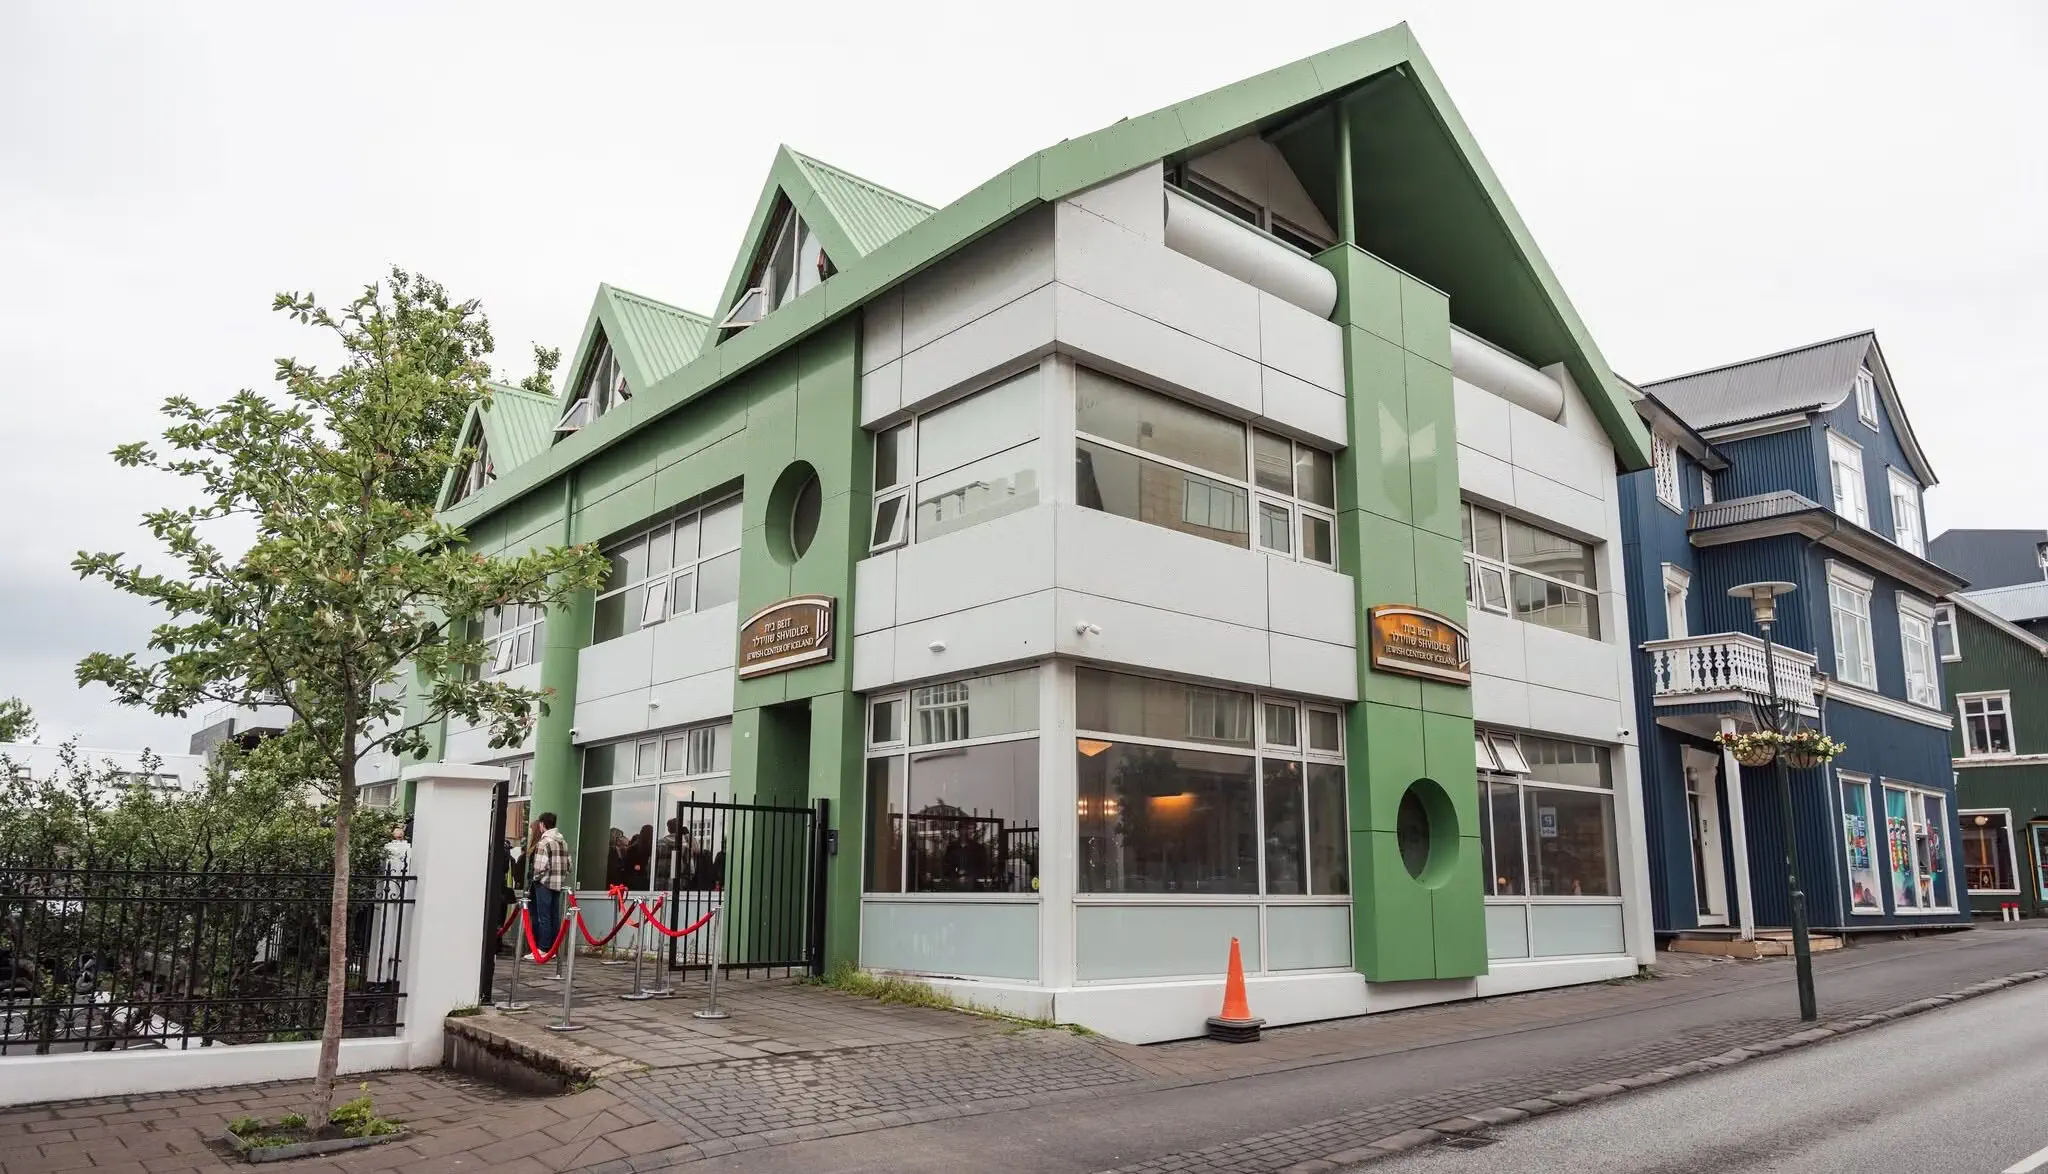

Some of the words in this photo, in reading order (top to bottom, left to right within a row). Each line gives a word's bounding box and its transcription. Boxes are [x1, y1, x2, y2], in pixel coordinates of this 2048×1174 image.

[764, 622, 775, 632] בית
[777, 618, 791, 629] BEIT
[1403, 624, 1415, 634] בית
[777, 625, 809, 641] SHVIDLER
[1418, 626, 1433, 637] BEIT
[746, 650, 764, 661] JEWISH
[764, 645, 782, 656] CENTER
[783, 643, 791, 651] OF
[791, 637, 814, 650] ICELAND
[1418, 638, 1451, 653] SHVIDLER
[1385, 644, 1406, 656] JEWISH
[1406, 649, 1426, 660] CENTER
[1426, 652, 1434, 661] OF
[1434, 655, 1457, 666] ICELAND
